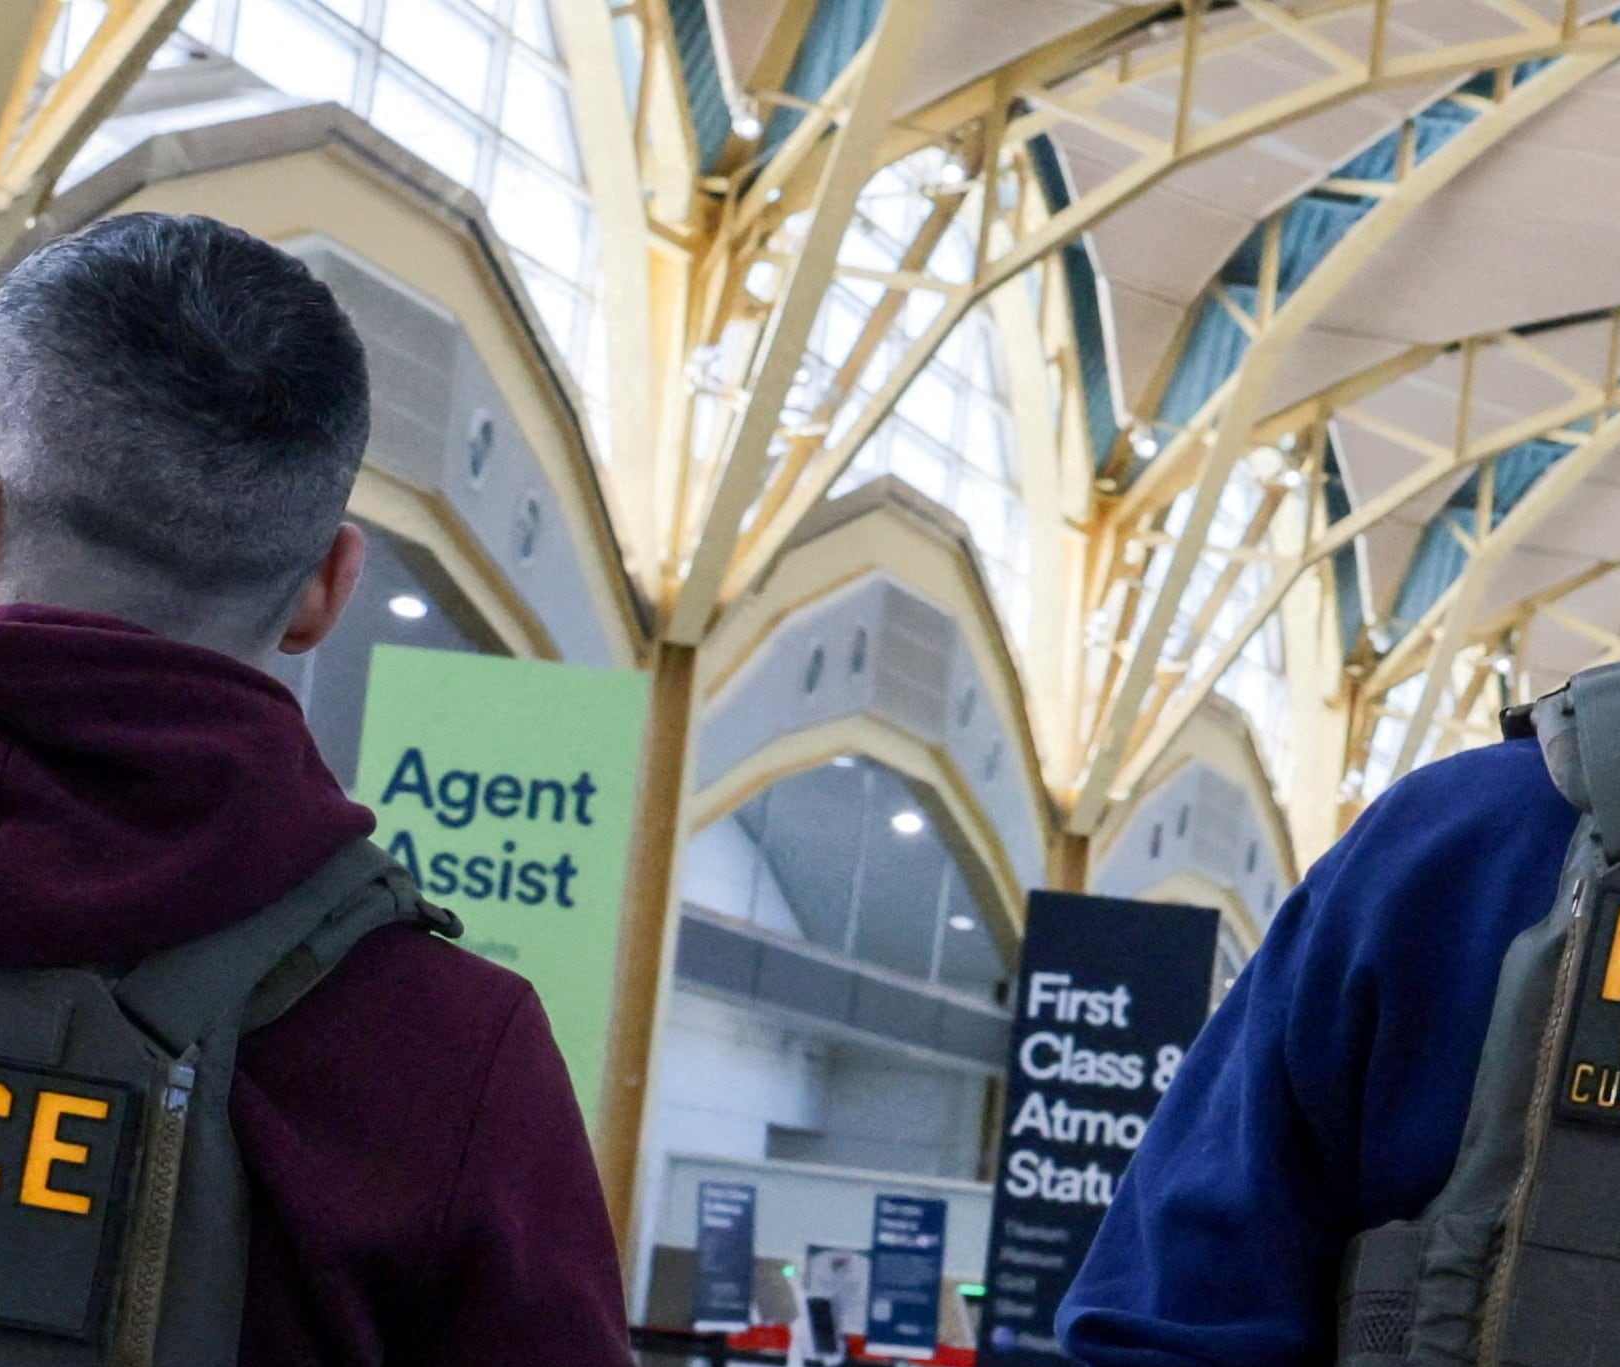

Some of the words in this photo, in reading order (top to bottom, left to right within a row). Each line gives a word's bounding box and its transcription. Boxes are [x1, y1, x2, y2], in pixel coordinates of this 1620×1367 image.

[380, 747, 596, 828] Agent
[385, 830, 578, 908] Assist
[1028, 971, 1132, 1028] First
[1019, 1031, 1144, 1090] Class
[1010, 1091, 1150, 1150] Atmo
[1005, 1149, 1116, 1206] Statu
